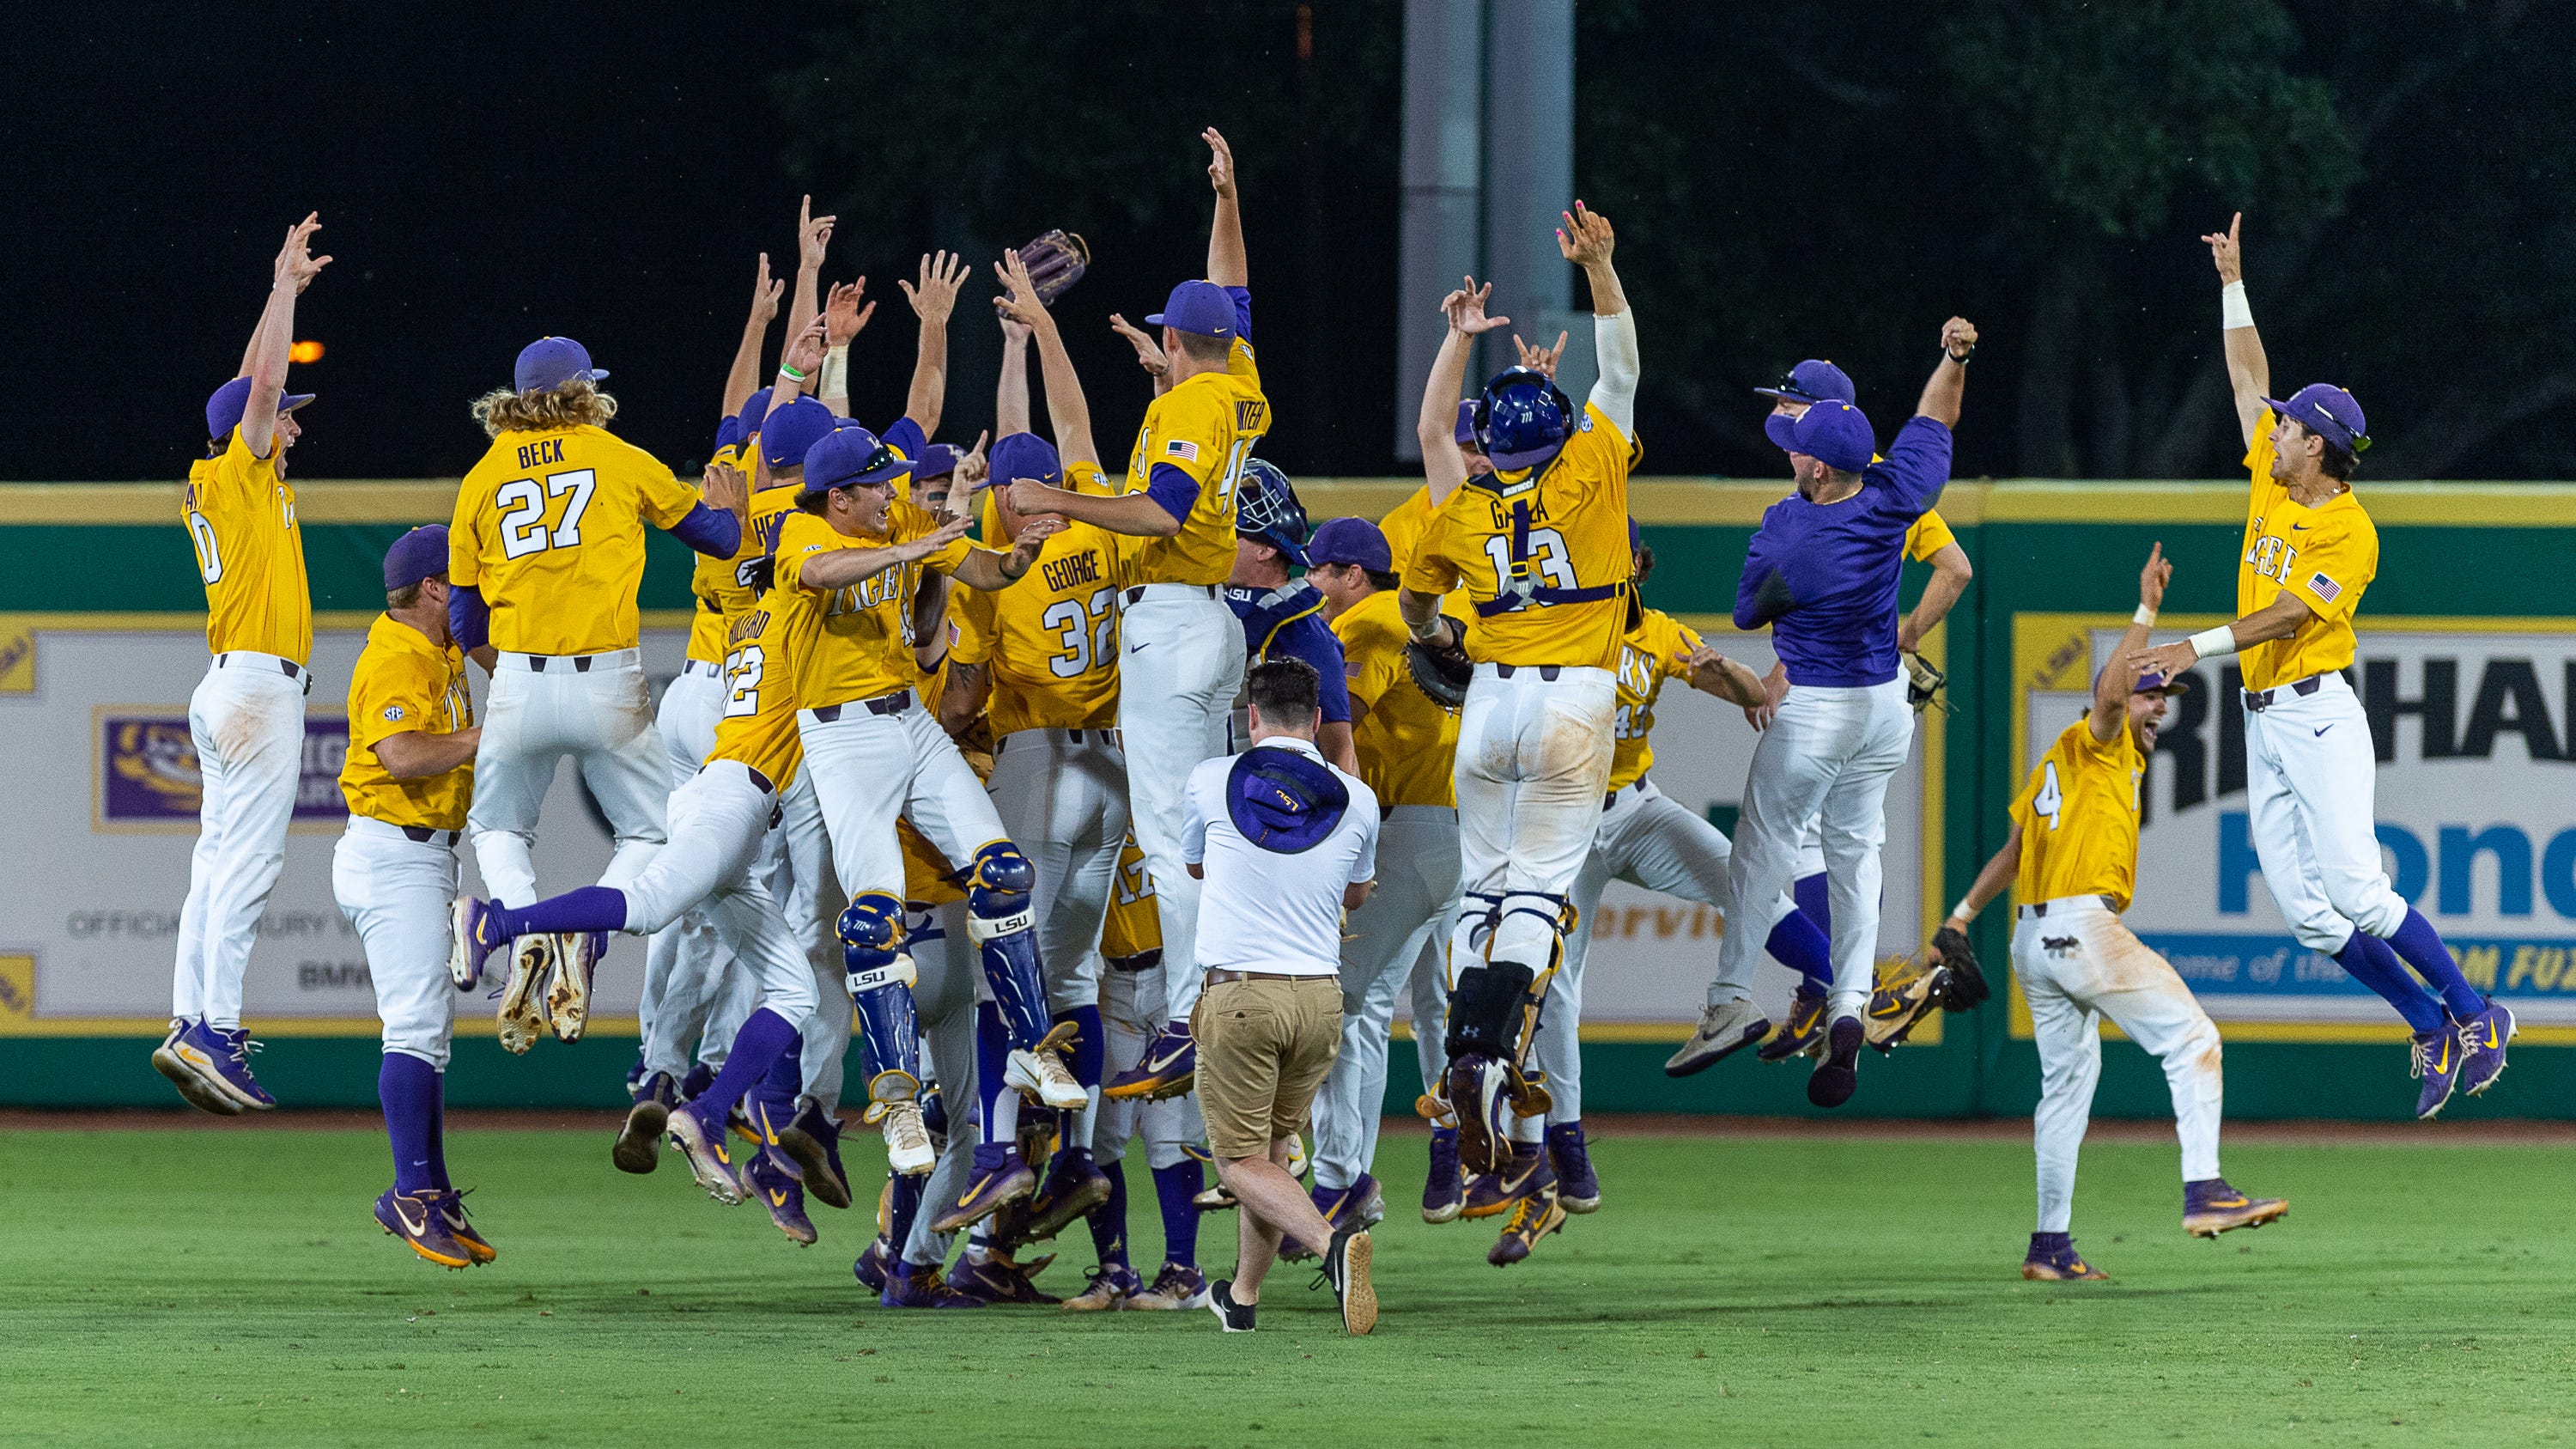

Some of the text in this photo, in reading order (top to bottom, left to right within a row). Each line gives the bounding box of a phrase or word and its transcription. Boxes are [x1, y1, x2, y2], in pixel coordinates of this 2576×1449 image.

[517, 438, 565, 470] BECK
[1503, 477, 1535, 498] marucci
[495, 468, 597, 561] 27
[1042, 550, 1102, 593] GEORGE
[1484, 526, 1582, 613] 13
[1228, 587, 1252, 603] LSU
[1042, 584, 1119, 679] 32
[1614, 703, 1649, 740] 43
[2032, 759, 2063, 832] 4
[1115, 856, 1156, 906] 17
[995, 916, 1028, 934] LSU
[854, 971, 885, 988] LSU
